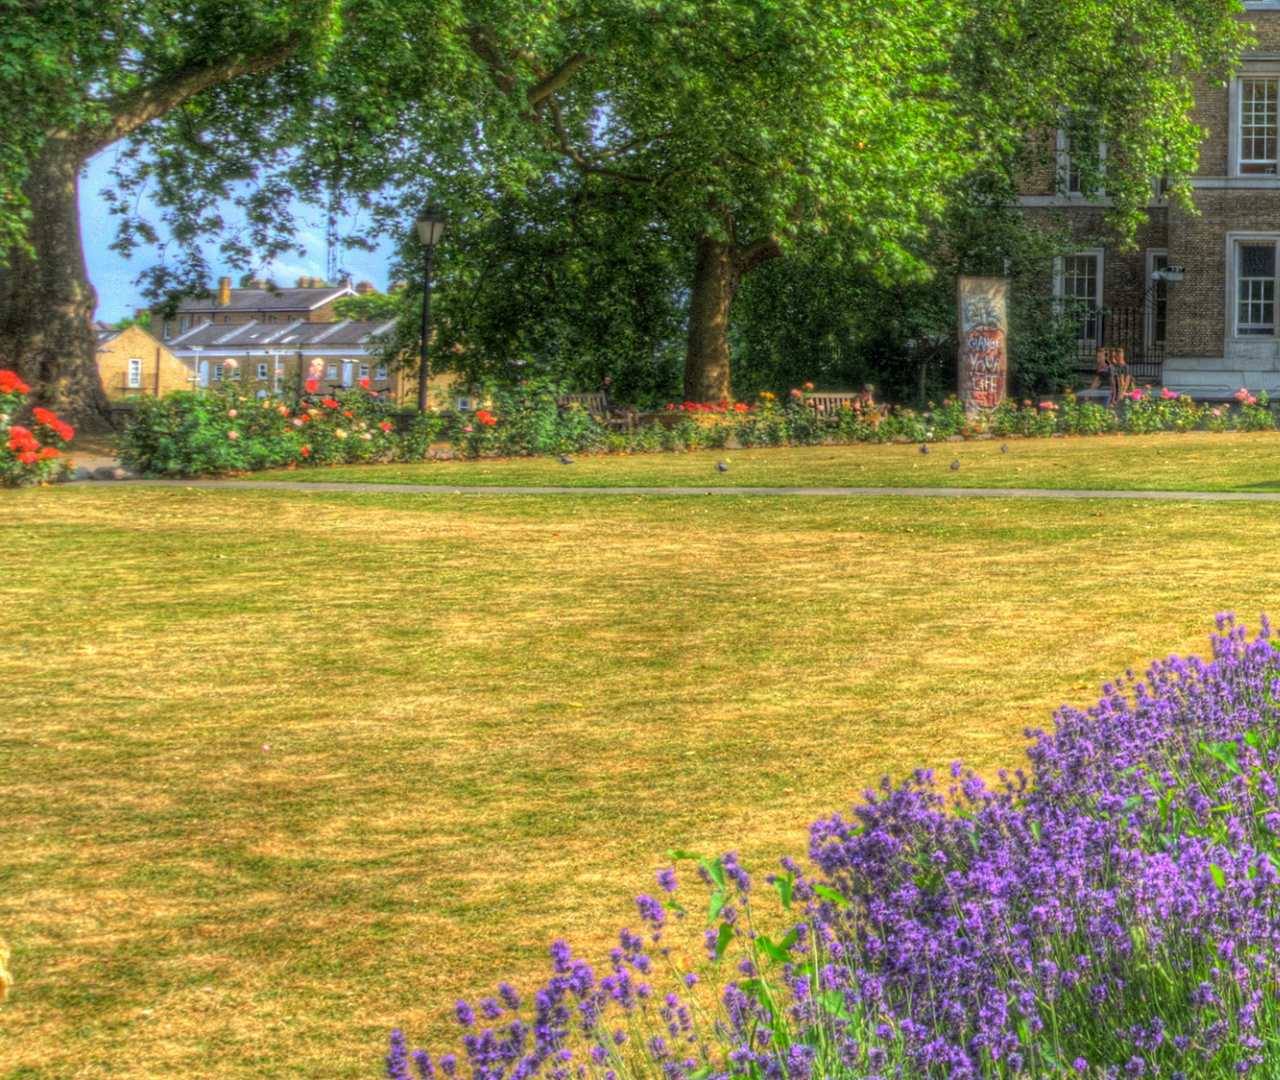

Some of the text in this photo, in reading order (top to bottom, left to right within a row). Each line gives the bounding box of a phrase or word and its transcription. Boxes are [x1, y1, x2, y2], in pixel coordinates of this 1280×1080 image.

[968, 336, 1000, 352] CHANGE
[969, 353, 1001, 376] YOUR
[972, 375, 998, 392] LIFE
